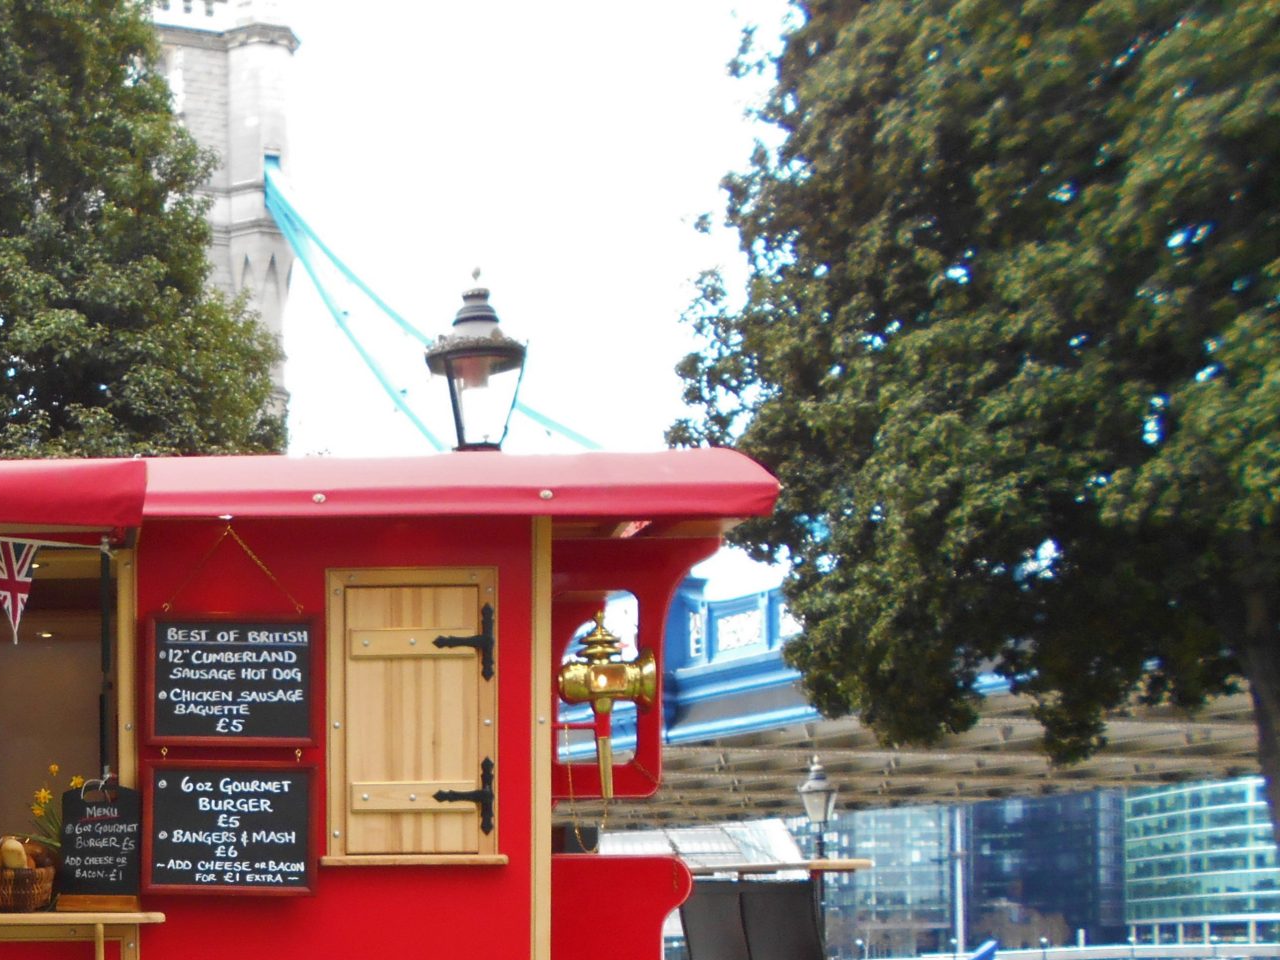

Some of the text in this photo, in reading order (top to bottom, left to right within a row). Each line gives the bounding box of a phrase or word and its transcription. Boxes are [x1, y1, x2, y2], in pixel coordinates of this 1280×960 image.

[167, 628, 308, 643] BEST OF BRITISH
[192, 650, 297, 663] CUMBERLAND
[169, 667, 302, 682] SAUSAGE HOT DOG
[170, 688, 303, 703] CHICKEN SAUSAGE
[174, 704, 250, 716] BAGUETTE
[216, 718, 245, 732] £5
[220, 778, 291, 794] GOURMET
[199, 798, 273, 812] BURGER
[86, 806, 118, 818] MENU
[217, 814, 240, 827] £5
[95, 823, 138, 834] GOURMET
[75, 836, 120, 849] BURGER
[172, 830, 236, 844] BANGERS
[252, 831, 296, 843] MASH
[215, 846, 238, 858] £6
[65, 856, 81, 866] ADD
[84, 856, 114, 865] CHEESE
[198, 861, 252, 871] CHEESE
[269, 861, 305, 871] BACON
[195, 872, 283, 882] FOR £1 EXTRA
